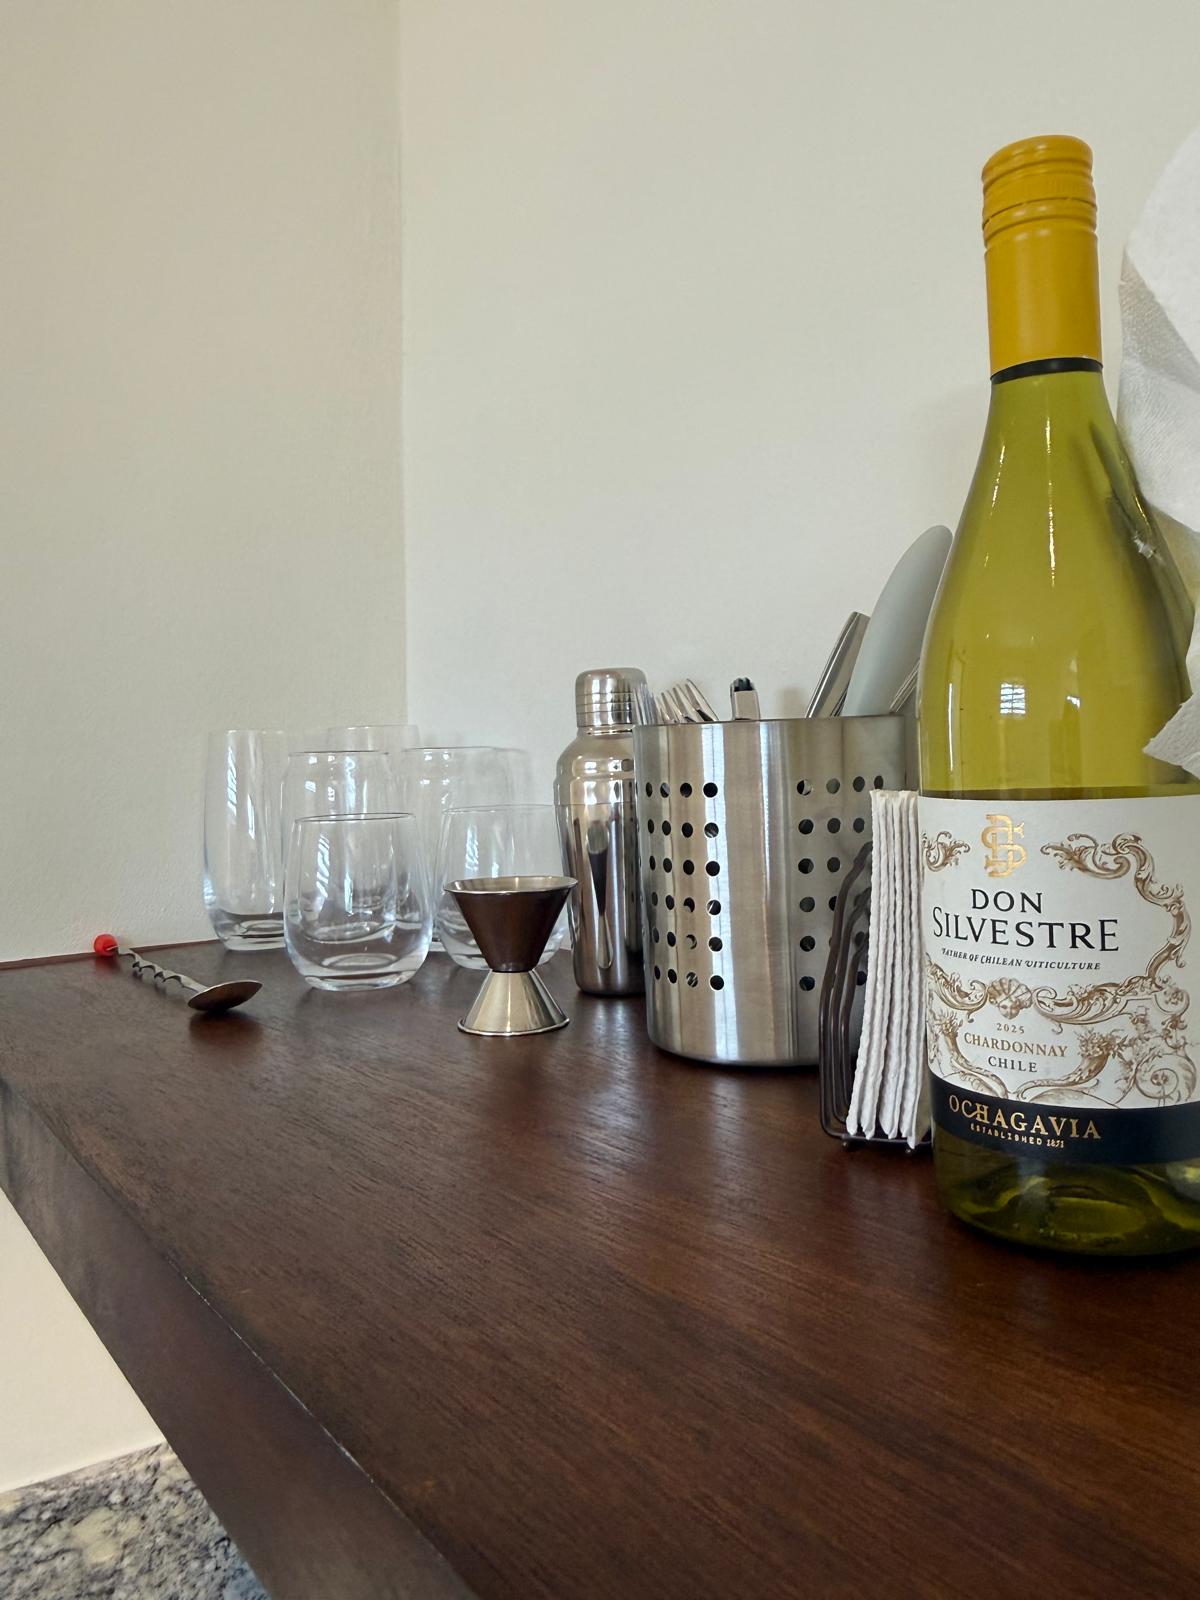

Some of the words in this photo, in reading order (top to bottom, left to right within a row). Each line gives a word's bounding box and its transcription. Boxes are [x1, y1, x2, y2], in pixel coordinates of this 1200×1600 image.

[971, 888, 1043, 914] DON
[932, 906, 1119, 952] SILVESTRE
[941, 947, 968, 961] FATHER
[968, 954, 980, 963] OF
[980, 955, 1023, 967] CHILEAN
[1025, 960, 1101, 970] VITICULTURE
[996, 1022, 1025, 1035] 2025
[964, 1032, 1068, 1057] CHARDONNAY
[988, 1056, 1038, 1073] CHILE
[949, 1094, 1101, 1139] OCHAGAVIA
[970, 1123, 1043, 1146] ESTABLISHED
[1046, 1138, 1065, 1149] 1851
